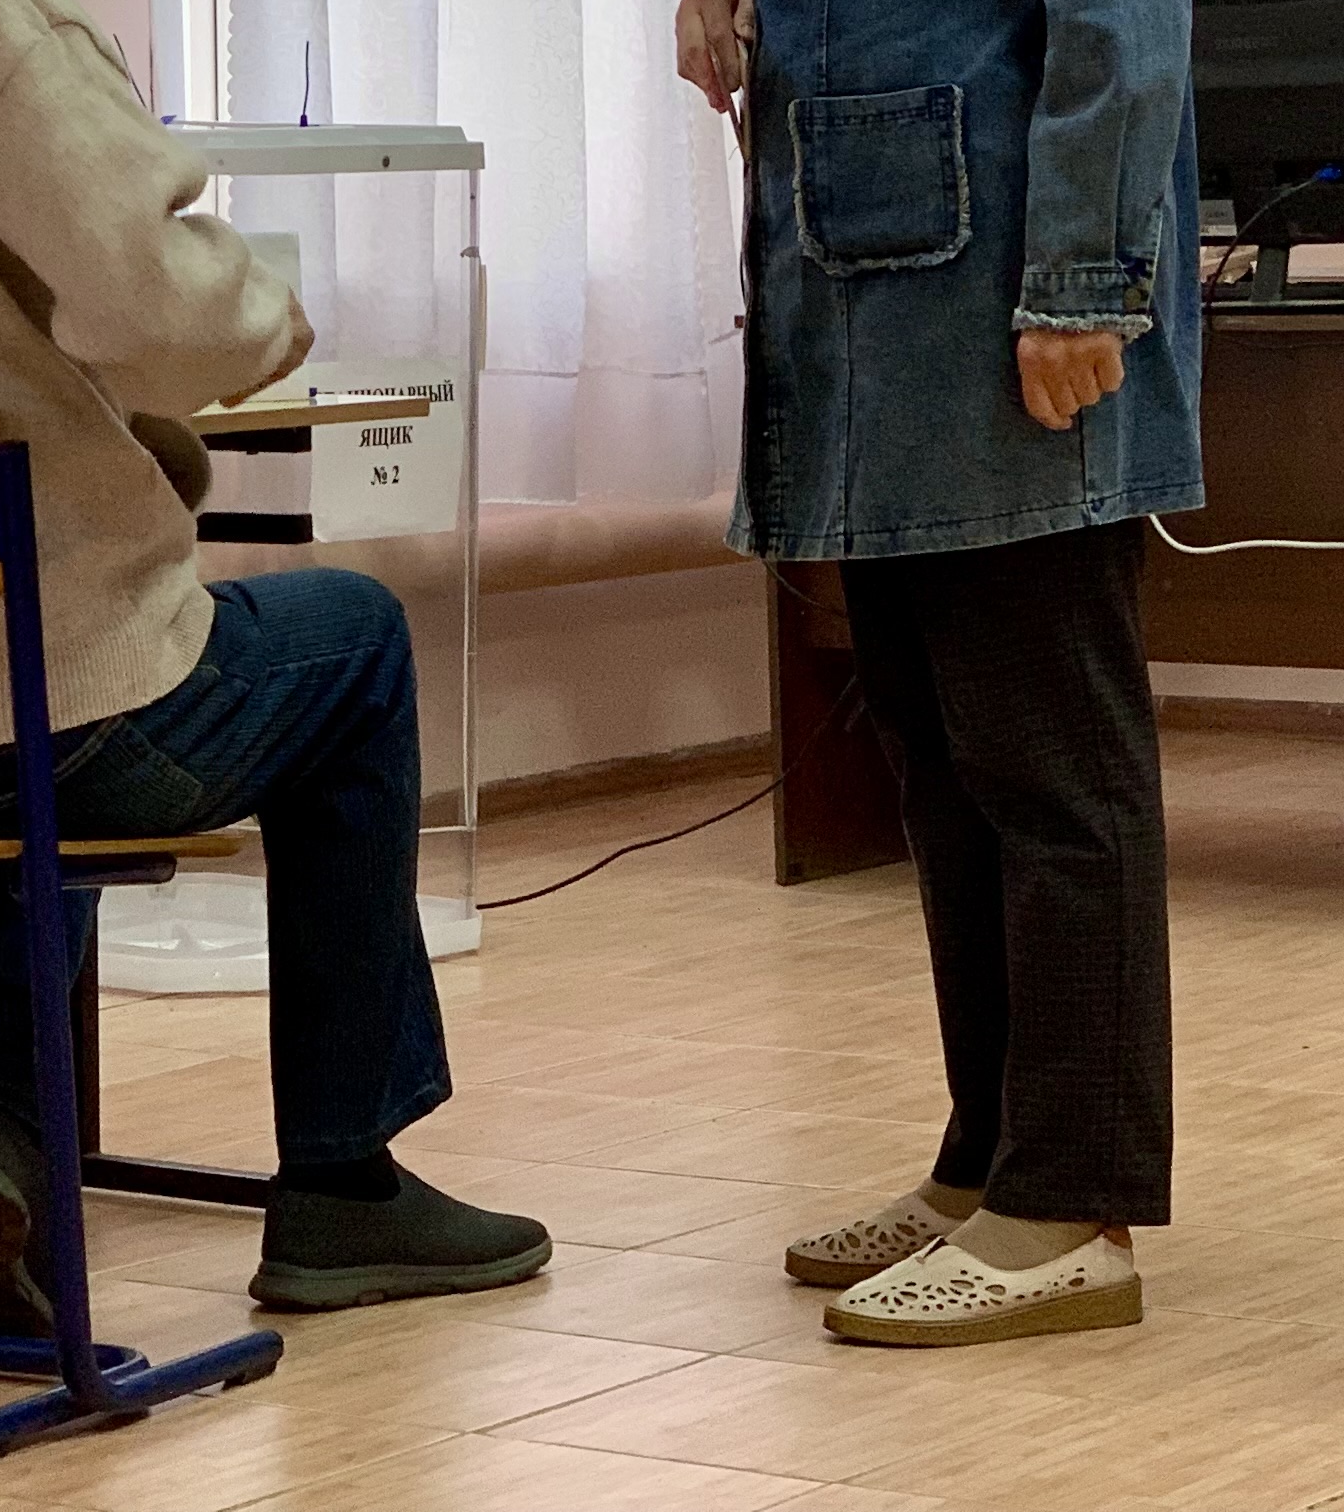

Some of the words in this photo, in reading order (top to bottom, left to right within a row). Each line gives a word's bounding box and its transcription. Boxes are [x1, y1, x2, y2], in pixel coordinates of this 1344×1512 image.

[359, 425, 414, 449] ЯЩИК
[370, 466, 388, 486] №
[392, 465, 400, 484] 2
